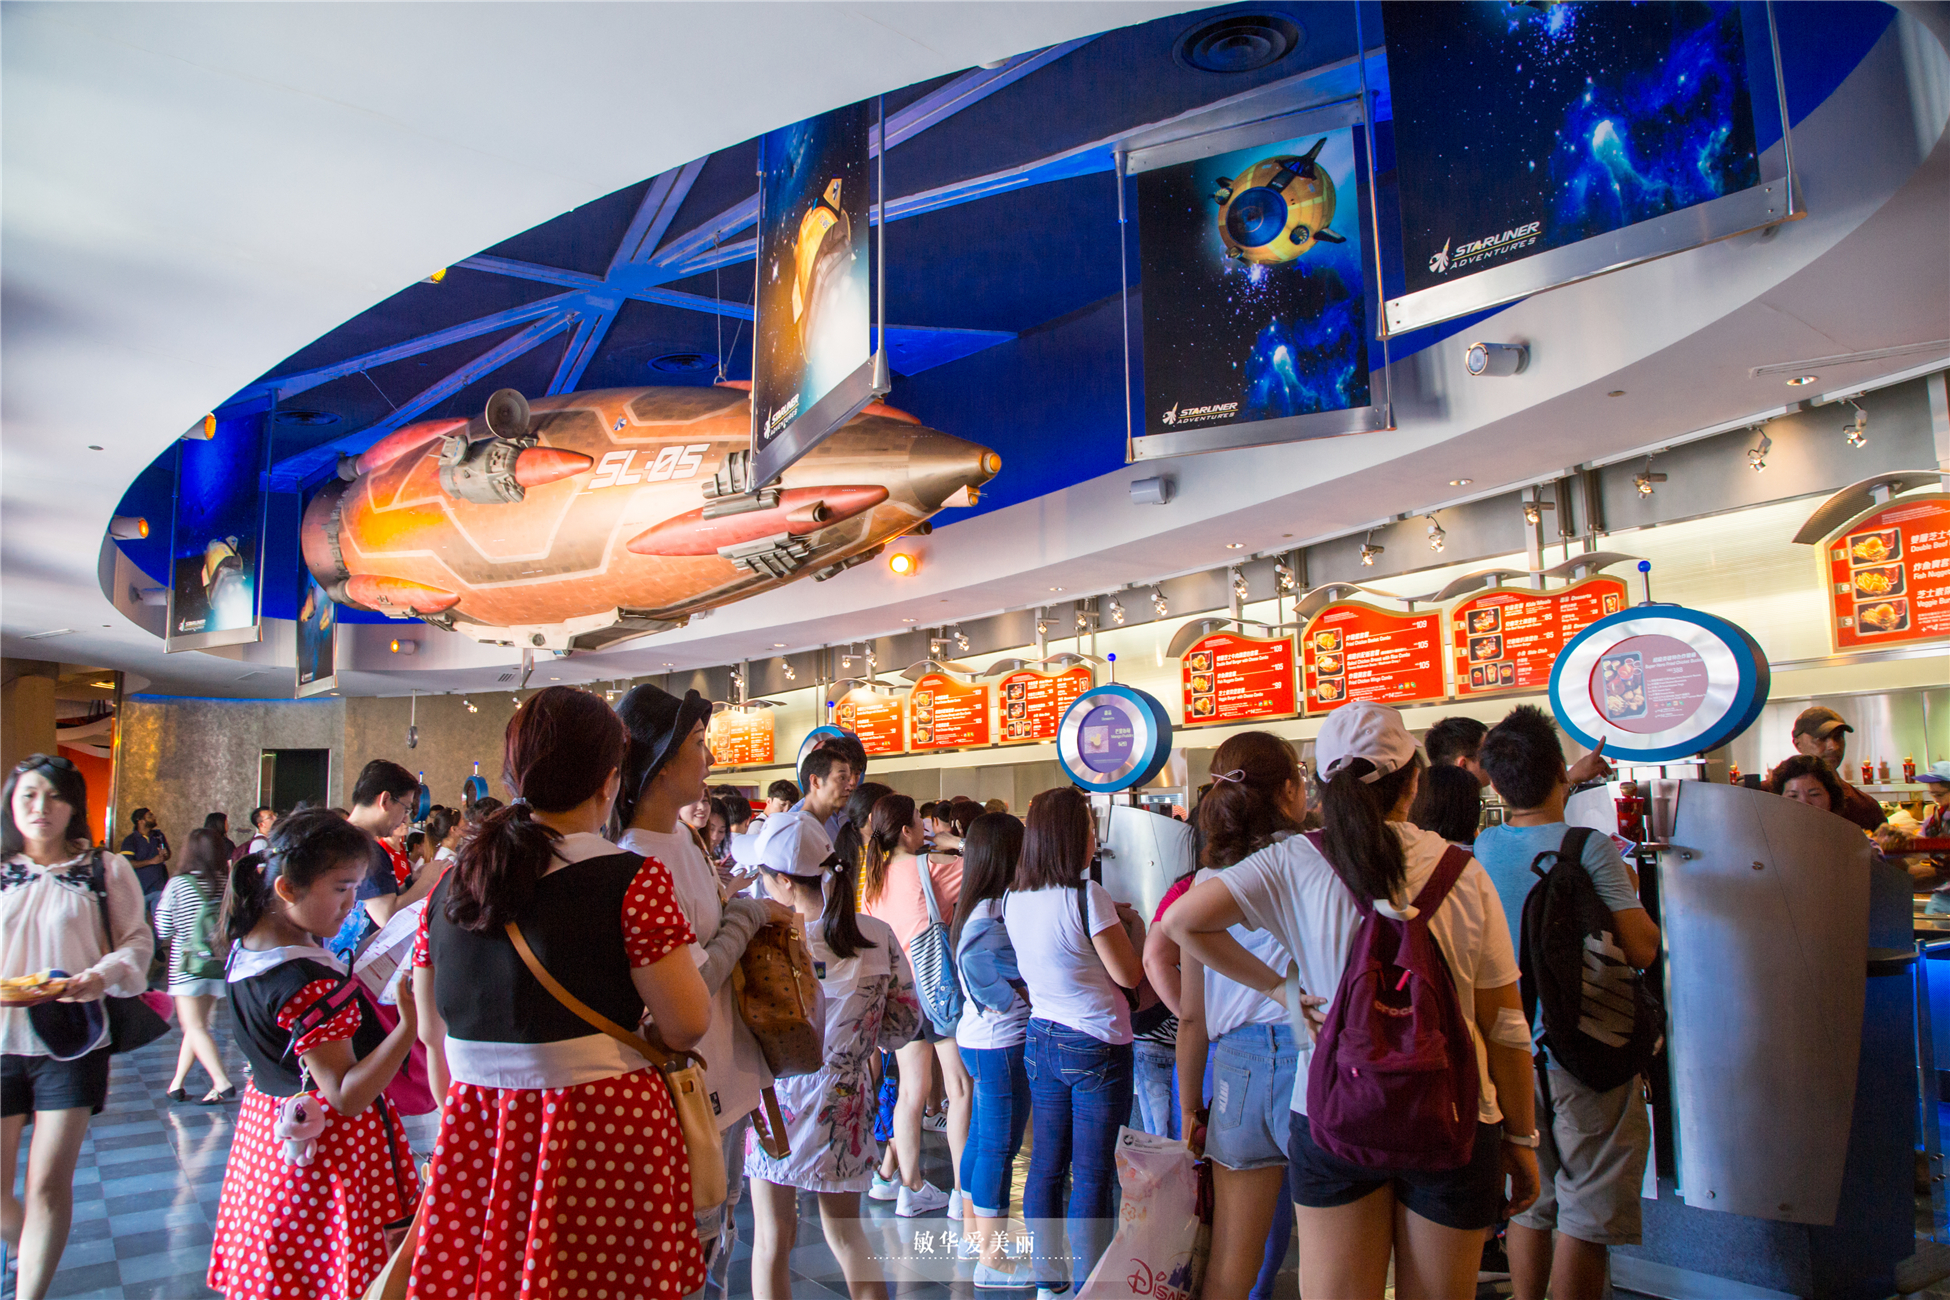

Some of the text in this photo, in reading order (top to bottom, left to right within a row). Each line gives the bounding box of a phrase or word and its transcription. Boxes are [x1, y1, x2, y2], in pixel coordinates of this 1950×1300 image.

[1454, 221, 1540, 257] STARLINER
[1450, 237, 1536, 270] ADVENTURES
[772, 393, 799, 425] STARLINER
[1180, 402, 1238, 417] STARLINER
[1177, 412, 1235, 424] ADVENTURES
[588, 444, 710, 489] SL-05
[1911, 540, 1948, 552] Double Beef
[1913, 558, 1950, 572] 炸魚寶套
[1917, 599, 1937, 608] Veggie
